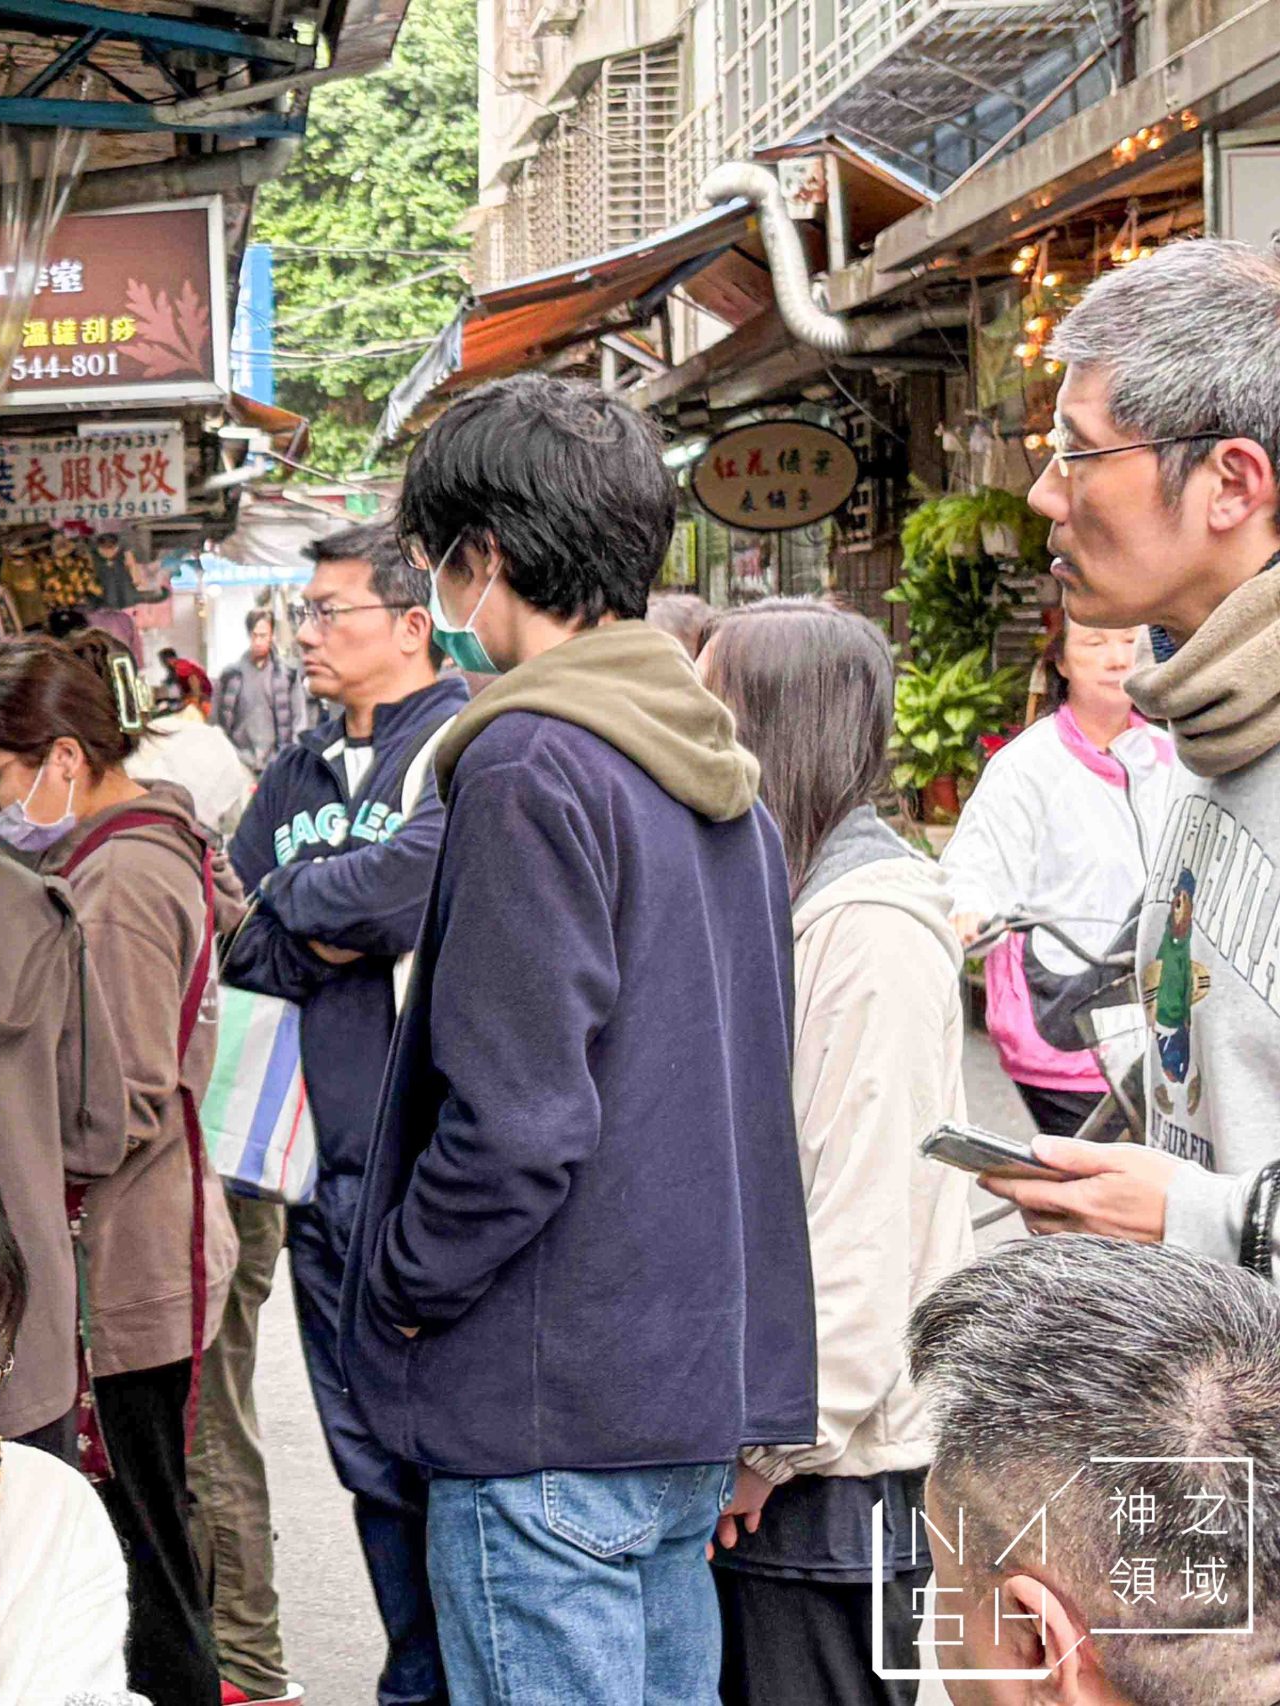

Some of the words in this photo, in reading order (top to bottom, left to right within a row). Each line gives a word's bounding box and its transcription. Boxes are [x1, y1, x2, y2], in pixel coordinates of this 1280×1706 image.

[25, 450, 177, 505] 衣服修改
[73, 498, 172, 520] 27629415
[274, 800, 405, 866] EAGLES
